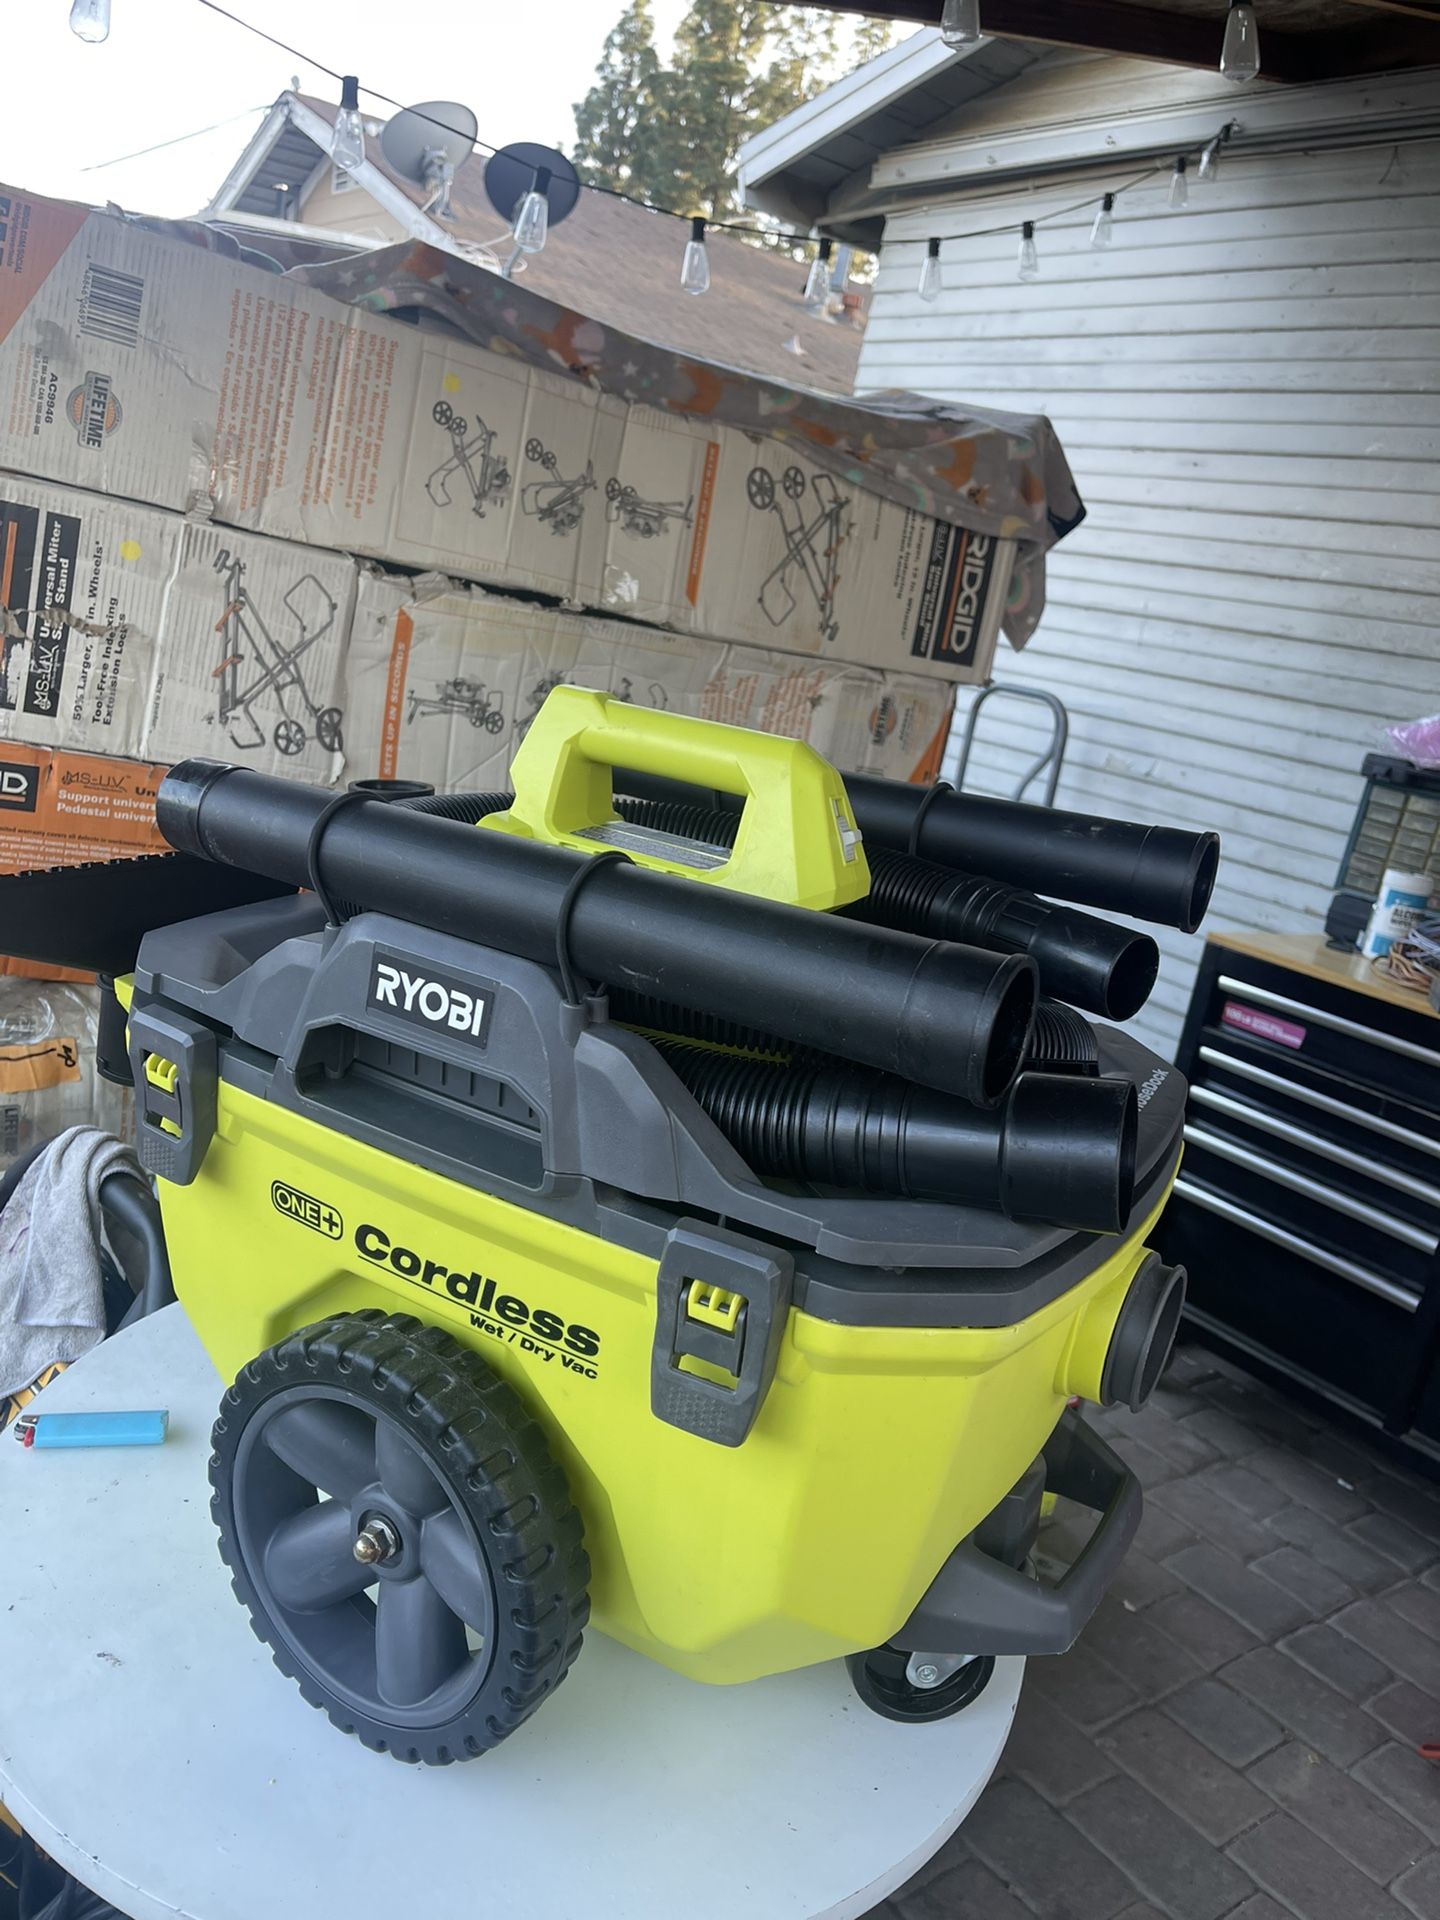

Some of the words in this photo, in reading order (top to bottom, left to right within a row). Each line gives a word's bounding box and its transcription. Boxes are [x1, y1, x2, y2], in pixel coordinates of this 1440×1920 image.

[228, 287, 240, 339] segundos
[245, 291, 252, 306] un
[267, 299, 275, 313] de
[276, 303, 287, 322] (12
[238, 308, 250, 351] plegado
[250, 295, 263, 353] Liberación
[260, 314, 272, 367] extensión
[295, 311, 308, 363] Pedestal
[314, 316, 325, 356] modèle
[328, 320, 335, 333] en
[225, 350, 233, 365] En
[235, 353, 245, 377] más
[247, 354, 256, 369] de
[279, 306, 295, 389] ingleteadoras
[320, 335, 332, 382] quelques
[367, 333, 377, 357] 50%
[373, 336, 386, 380] onglets
[383, 339, 397, 386] Support
[269, 356, 278, 381] 50%
[362, 359, 372, 381] plus
[43, 372, 59, 424] AC9946
[84, 375, 111, 447] LIFETIME
[217, 366, 230, 433] comparación
[229, 378, 241, 413] rápido
[241, 370, 254, 415] peldaño
[250, 367, 265, 425] graduables
[265, 382, 275, 406] más
[287, 365, 299, 418] universal
[313, 384, 325, 433] secondes
[356, 383, 368, 424] grandes
[369, 392, 379, 422] Roues
[258, 406, 271, 449] grandes
[272, 399, 282, 438] Ruedas
[280, 420, 290, 446] para
[334, 409, 341, 422] en
[366, 424, 373, 437] de
[269, 440, 277, 454] de
[342, 429, 350, 452] sans
[363, 441, 372, 460] 305
[371, 443, 381, 468] pour
[241, 444, 254, 512] herramientas
[275, 448, 287, 489] sierras
[304, 444, 317, 490] Comparé
[338, 455, 347, 479] outil
[360, 462, 367, 481] mm
[368, 473, 378, 494] scie
[353, 501, 362, 519] po)
[357, 483, 365, 499] (12
[47, 519, 62, 563] Miter
[54, 556, 70, 604] Stand
[950, 534, 990, 654] RIDGID
[38, 563, 57, 639] Uversal
[85, 601, 96, 620] in.
[101, 596, 118, 659] Indexing
[76, 642, 93, 691] Larger,
[390, 640, 406, 704] SECONDS
[72, 692, 85, 721] 50%
[387, 706, 397, 720] IN
[870, 696, 890, 743] LIFETIME
[385, 721, 396, 741] UP
[381, 743, 394, 775] SETS
[56, 802, 110, 818] Pedestal
[58, 789, 110, 805] Support
[376, 963, 485, 1037] RYOBI
[1136, 1066, 1169, 1113] oseDock
[354, 1223, 601, 1357] Cordless
[469, 1313, 504, 1340] Wet
[509, 1333, 516, 1343] /
[519, 1337, 556, 1362] Dry
[559, 1357, 599, 1380] Vac
